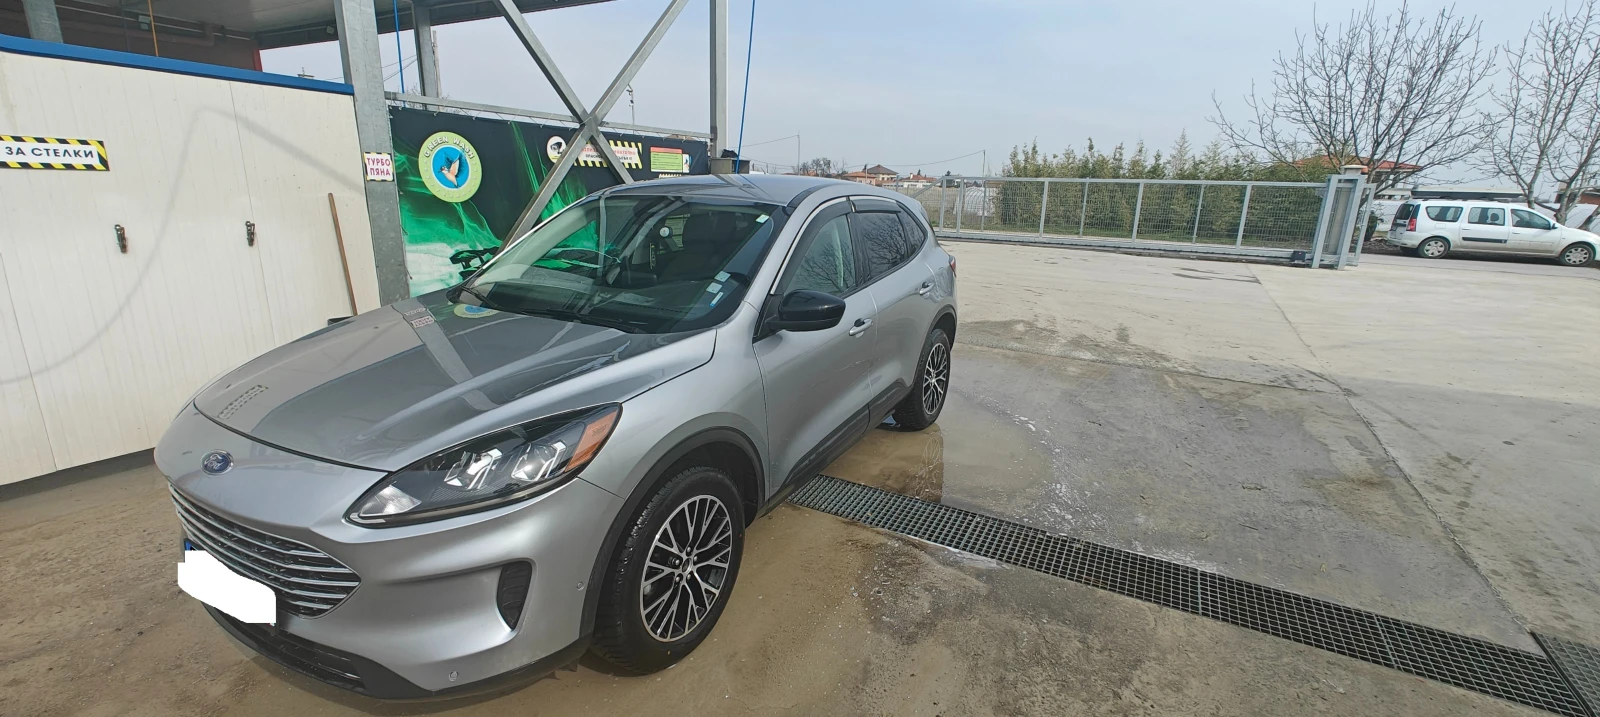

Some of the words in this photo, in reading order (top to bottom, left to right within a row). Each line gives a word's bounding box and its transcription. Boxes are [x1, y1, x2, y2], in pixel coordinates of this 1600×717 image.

[5, 146, 26, 156] ЗА
[31, 147, 94, 159] СТЕЛКИ
[424, 136, 449, 158] GREEN
[453, 137, 475, 159] WASH
[366, 157, 391, 167] ТУРБО
[369, 167, 391, 176] ПЯНА
[204, 453, 226, 470] Ford
